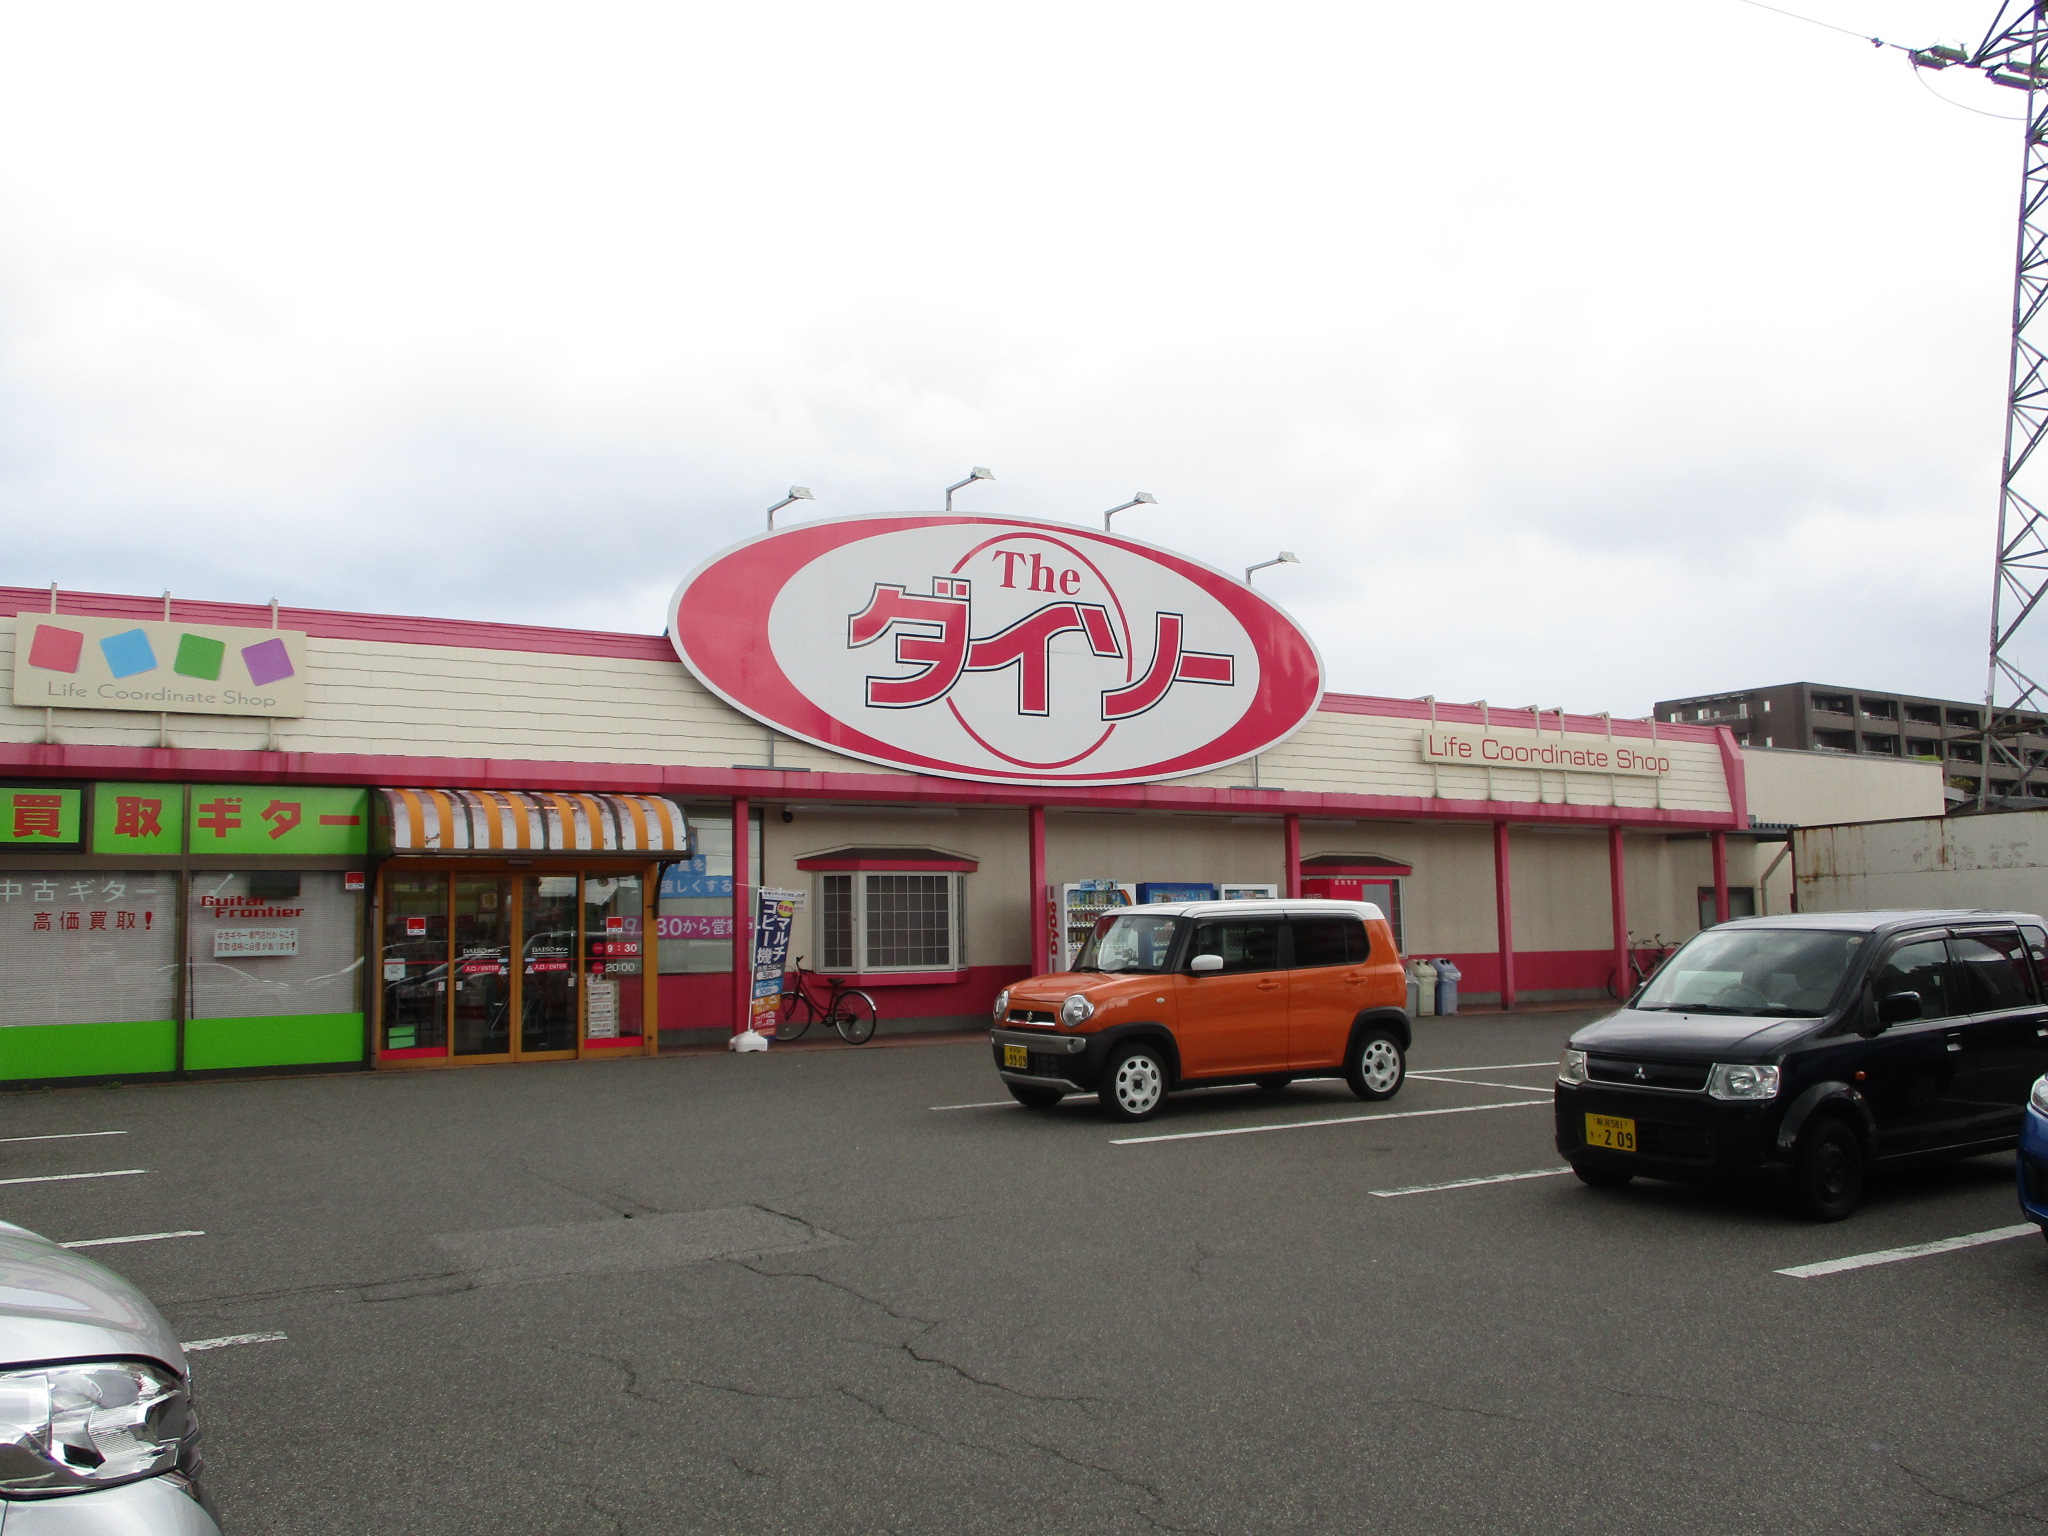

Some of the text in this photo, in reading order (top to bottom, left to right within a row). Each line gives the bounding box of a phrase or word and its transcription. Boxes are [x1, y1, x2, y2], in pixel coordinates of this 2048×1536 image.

[992, 549, 1081, 596] The
[847, 576, 1234, 721] ダイソー
[48, 681, 277, 708] Life Coordinate Shop
[1429, 735, 1670, 775] Life Coordinate Shop
[0, 879, 157, 902] 中古ギター
[201, 895, 267, 907] Guitar
[215, 906, 304, 918] Frontier
[1049, 901, 1059, 954] DyDo
[757, 901, 777, 964] コピー機
[773, 917, 790, 961] マルチ
[605, 963, 635, 972] 20:00
